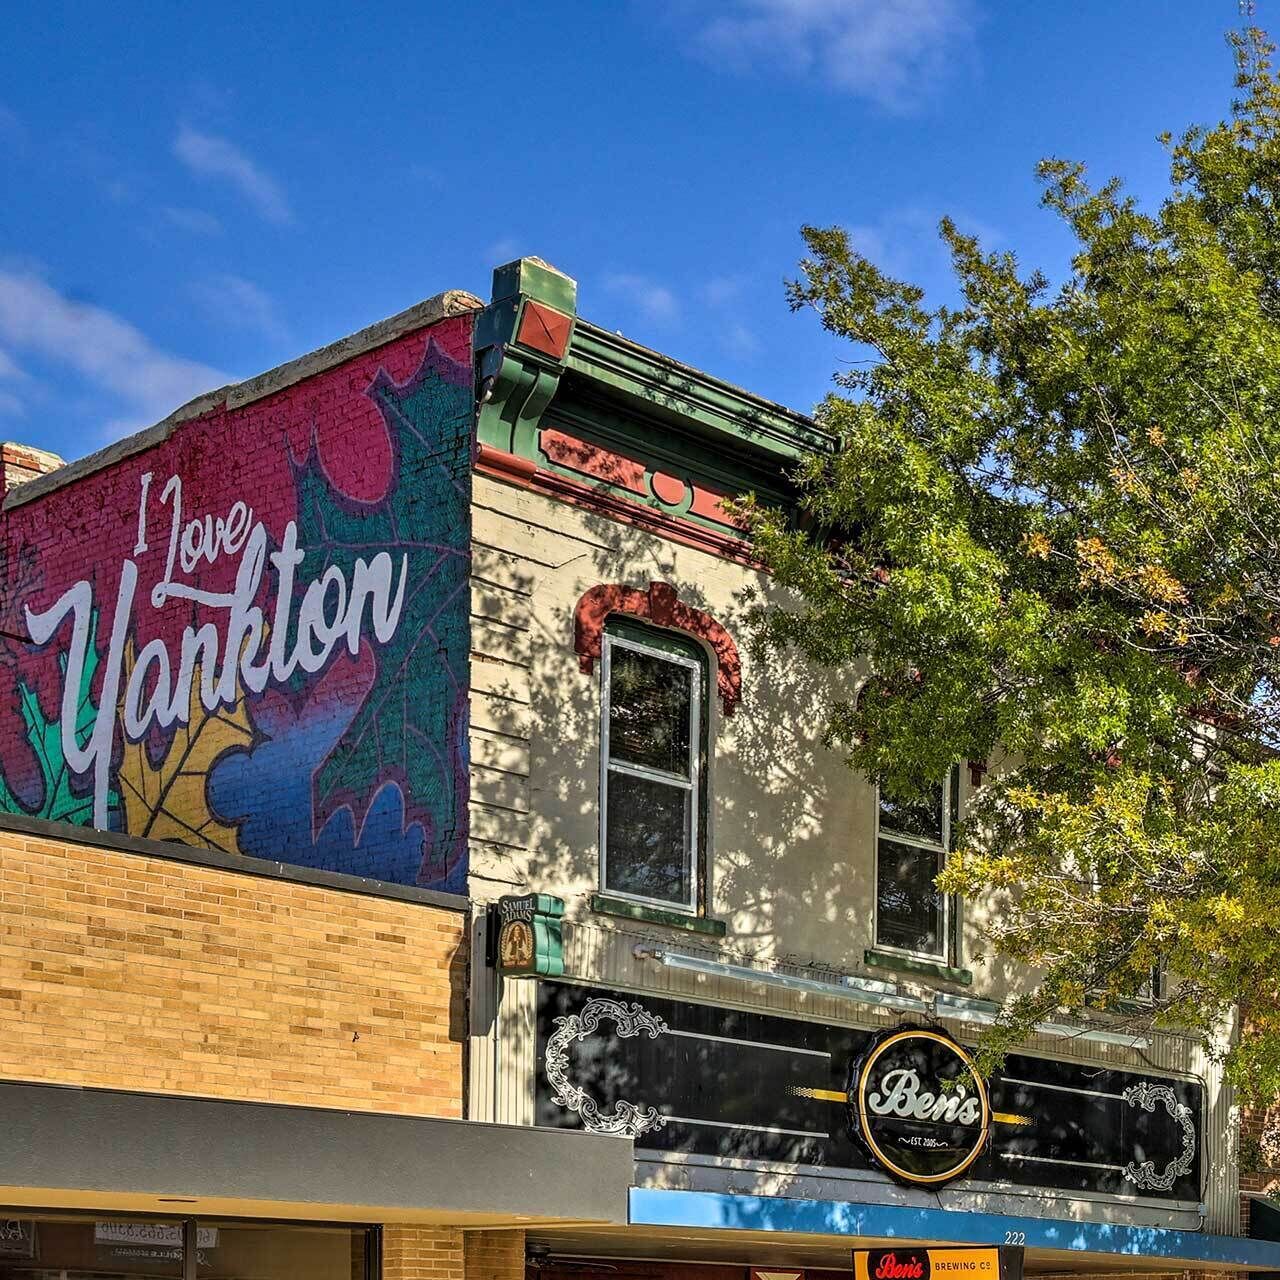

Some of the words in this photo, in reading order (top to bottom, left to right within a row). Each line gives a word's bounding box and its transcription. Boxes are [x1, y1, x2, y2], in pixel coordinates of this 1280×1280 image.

[134, 472, 153, 557] I
[152, 474, 254, 608] Love
[24, 520, 409, 832] Yankton
[502, 899, 535, 914] SAMUEL
[503, 909, 532, 925] ADAMS
[868, 1068, 980, 1125] Ben's
[1004, 1231, 1026, 1246] 222
[875, 1252, 924, 1279] Ben's
[935, 1262, 976, 1271] BREWING
